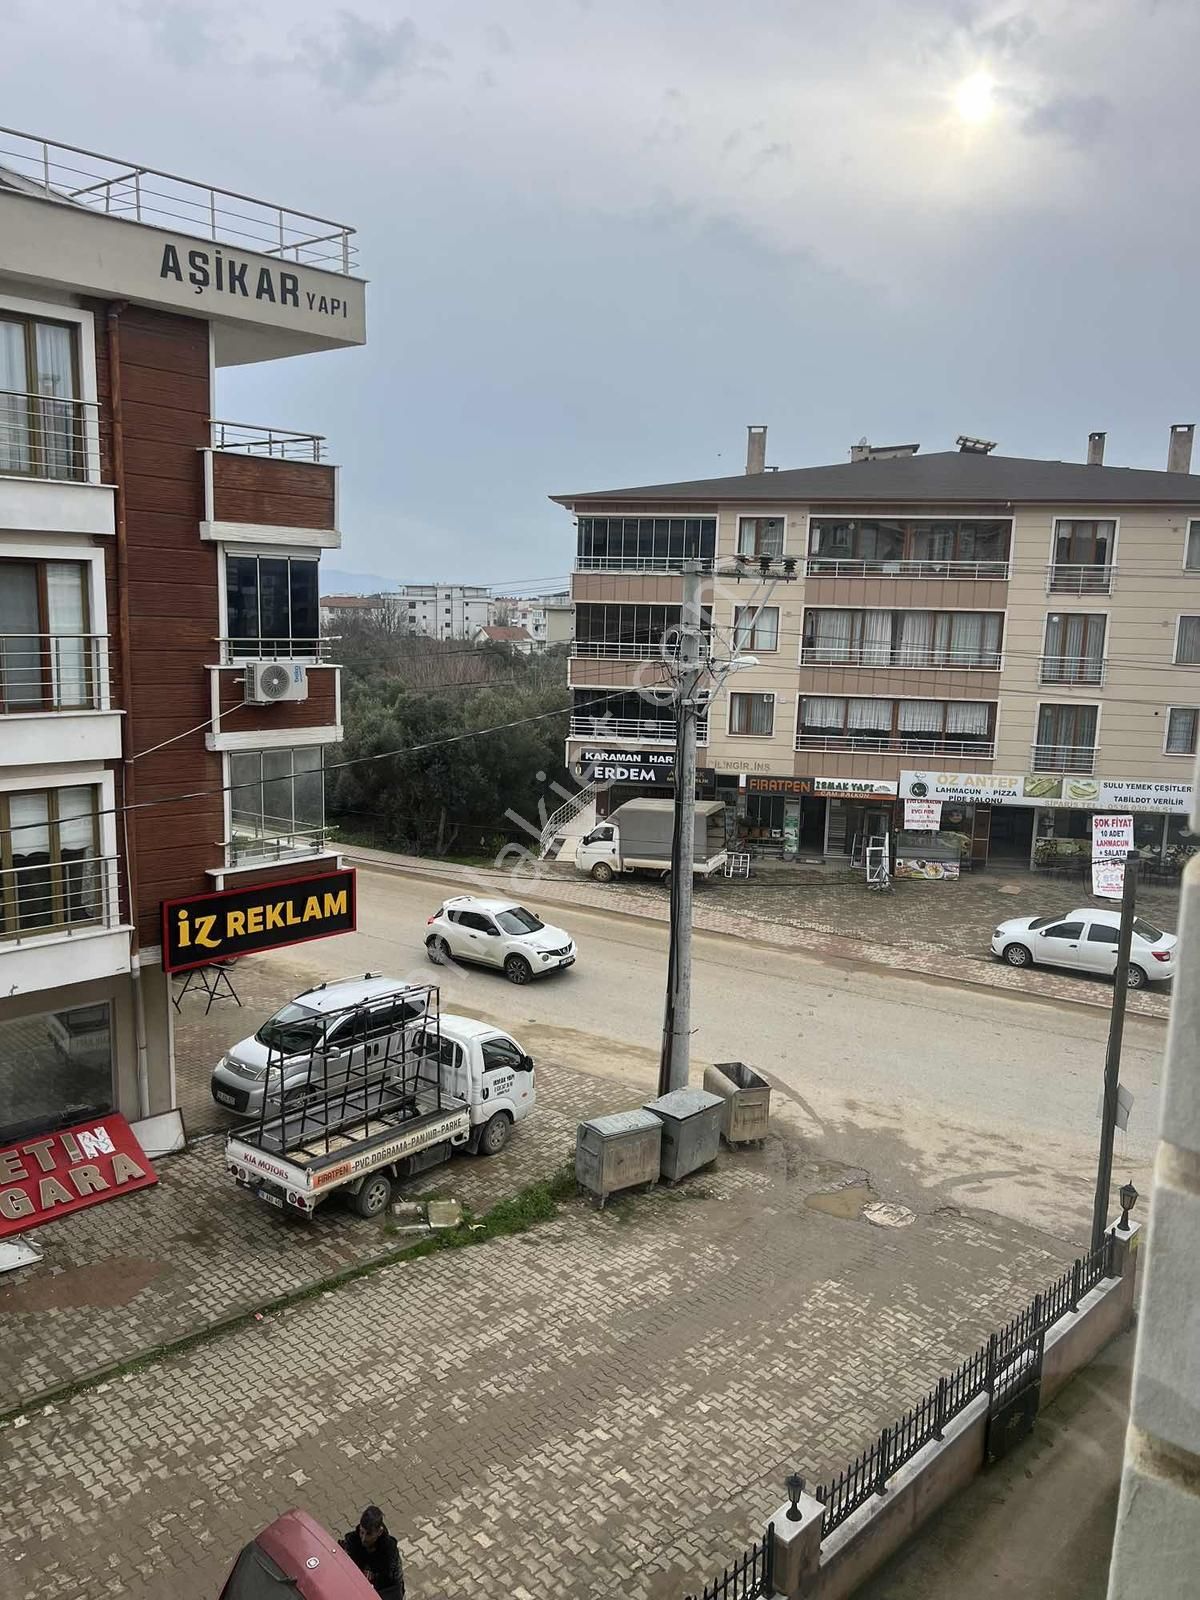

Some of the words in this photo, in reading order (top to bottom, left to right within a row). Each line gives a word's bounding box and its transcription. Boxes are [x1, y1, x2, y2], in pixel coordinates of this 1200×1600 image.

[160, 244, 300, 307] AŞİKAR
[306, 292, 347, 318] YAPI
[585, 752, 641, 762] KARAMAN
[649, 755, 673, 763] HAR
[594, 766, 656, 781] ERDEM
[749, 779, 811, 792] FIRATPEN
[964, 775, 1018, 788] ANTEP
[1125, 783, 1152, 791] YEMEK
[935, 787, 982, 795] LAHMACUN
[1114, 795, 1151, 804] TABİLDOT
[1111, 816, 1132, 827] FİYAT
[227, 890, 347, 938] REKLAM
[244, 1152, 257, 1165] KIA
[258, 1160, 288, 1180] MOTORS
[317, 1165, 348, 1185] FIRATPEN
[0, 1153, 146, 1219] GARA
